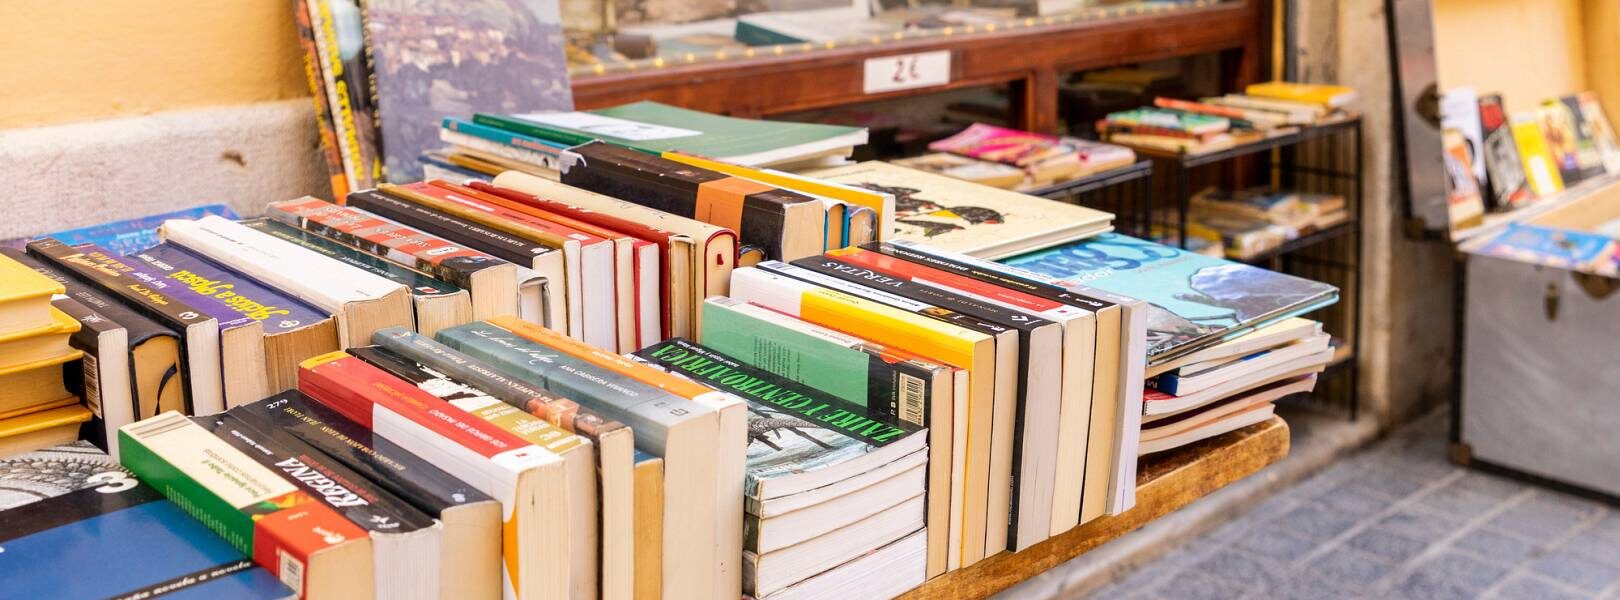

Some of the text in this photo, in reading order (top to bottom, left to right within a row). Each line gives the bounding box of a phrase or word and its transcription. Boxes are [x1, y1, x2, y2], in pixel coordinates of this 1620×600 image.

[892, 54, 920, 82] 2€
[821, 261, 904, 287] VERITAS
[650, 344, 813, 409] CENTROAFRICA
[802, 403, 830, 416] Y
[817, 408, 905, 442] ZAIRE
[275, 457, 369, 508] REGINA
